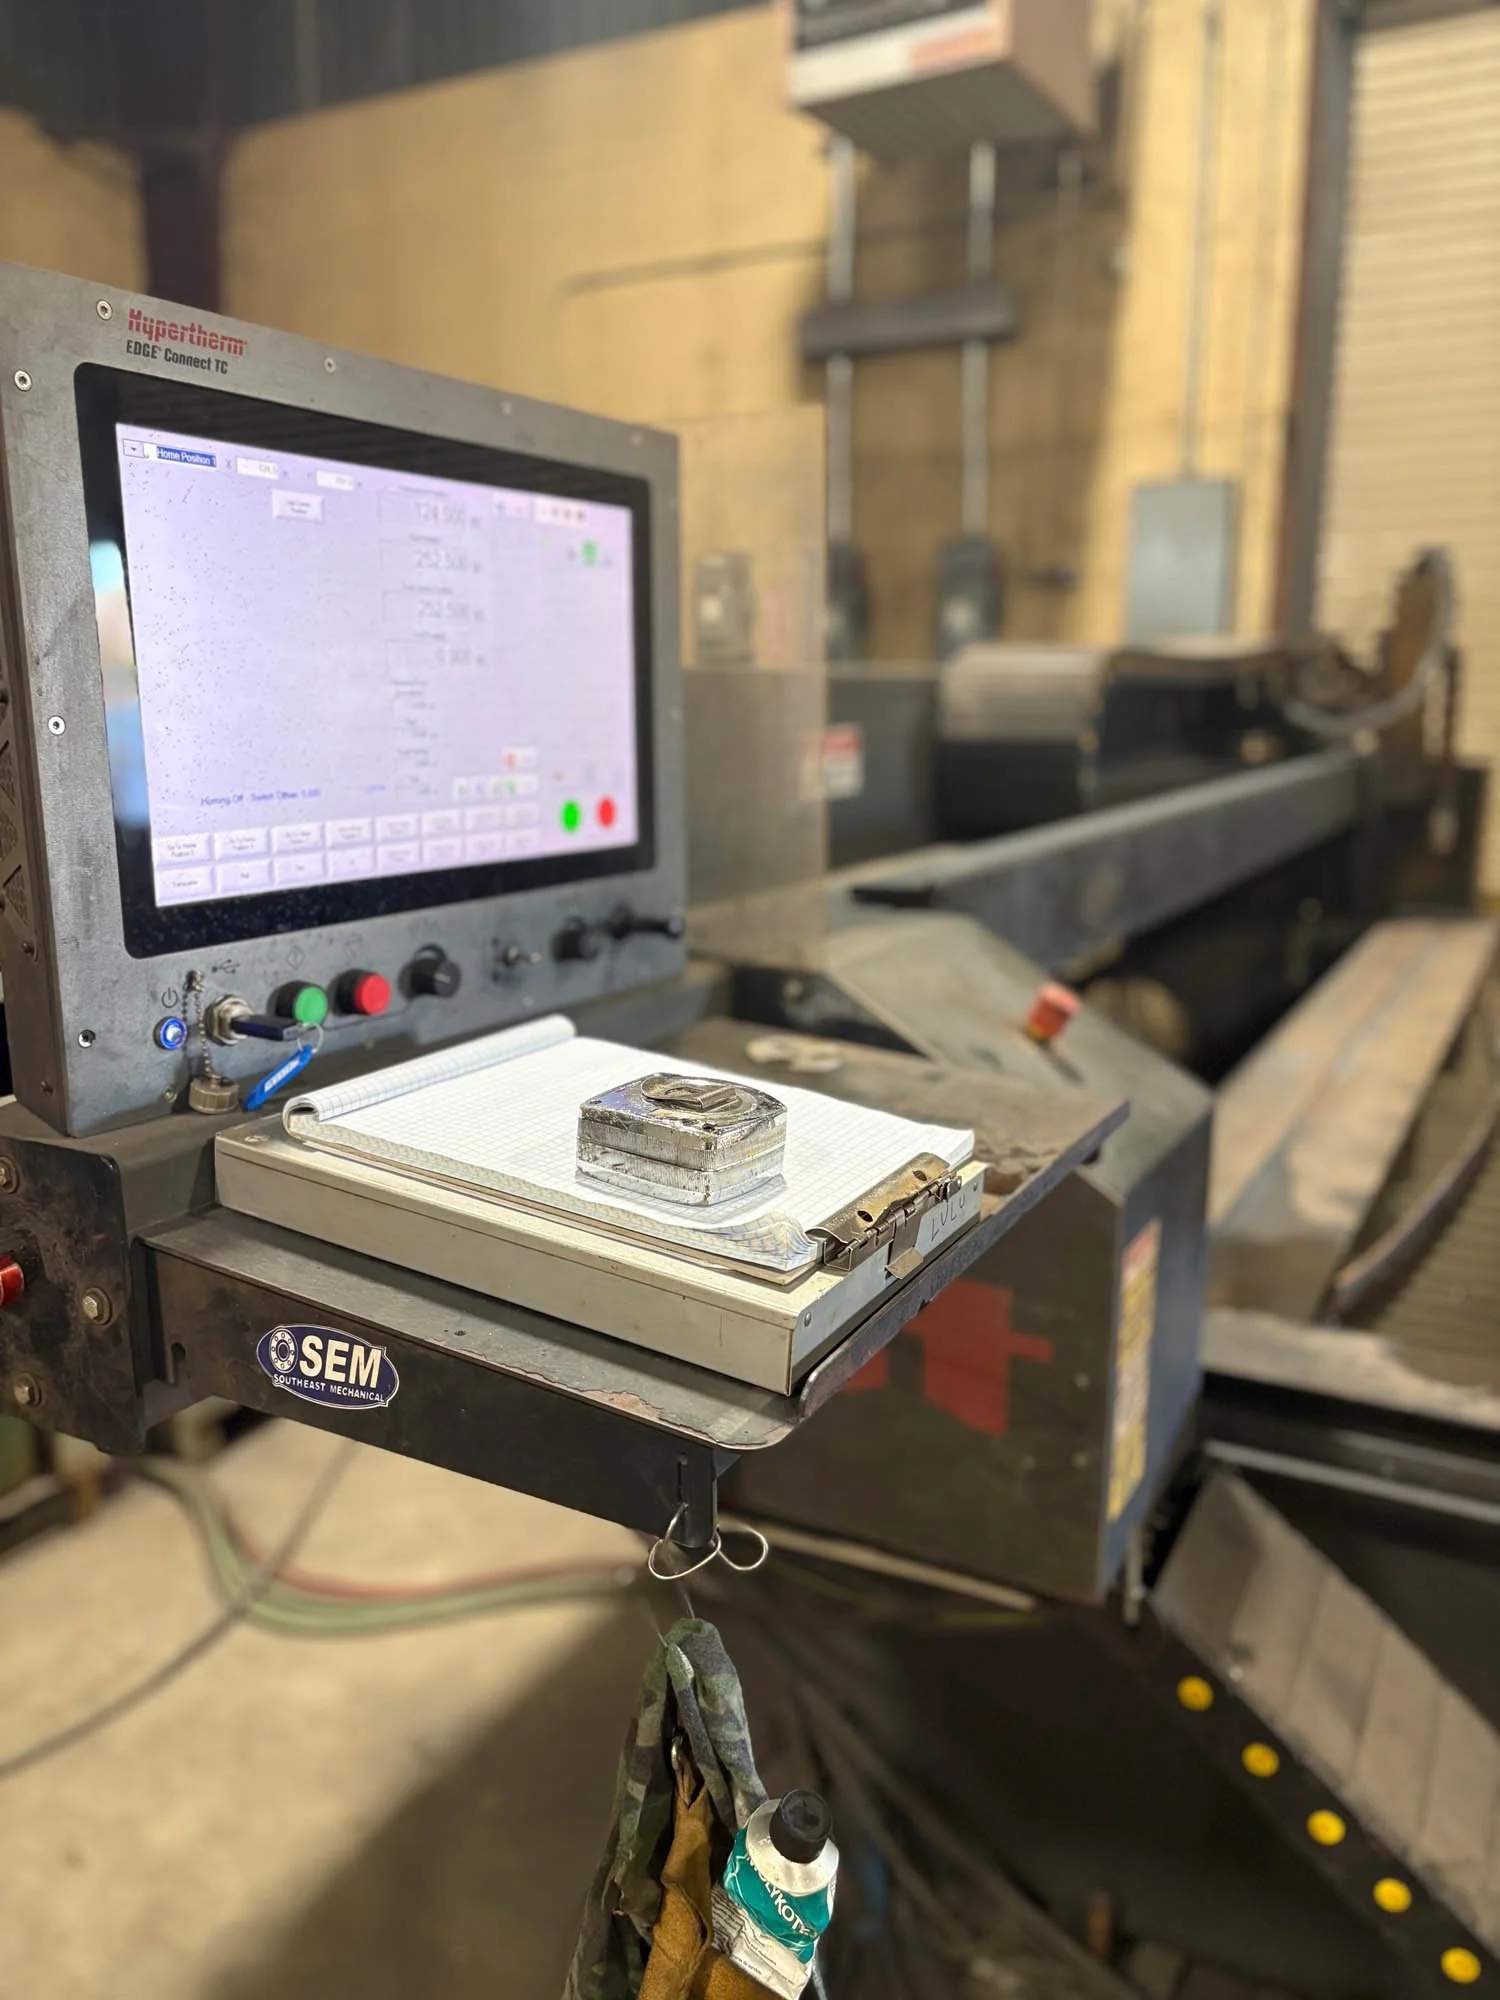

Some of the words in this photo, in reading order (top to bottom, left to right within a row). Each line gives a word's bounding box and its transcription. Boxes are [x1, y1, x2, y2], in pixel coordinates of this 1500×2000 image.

[128, 308, 244, 357] Hypertherm
[163, 347, 211, 372] Connect
[214, 358, 229, 375] TC
[157, 447, 180, 461] Home
[300, 1334, 382, 1389] SEM
[273, 1373, 326, 1392] SOUTHEAST
[329, 1384, 385, 1403] MECHANICAL
[748, 1857, 811, 1936] LYKOTE
